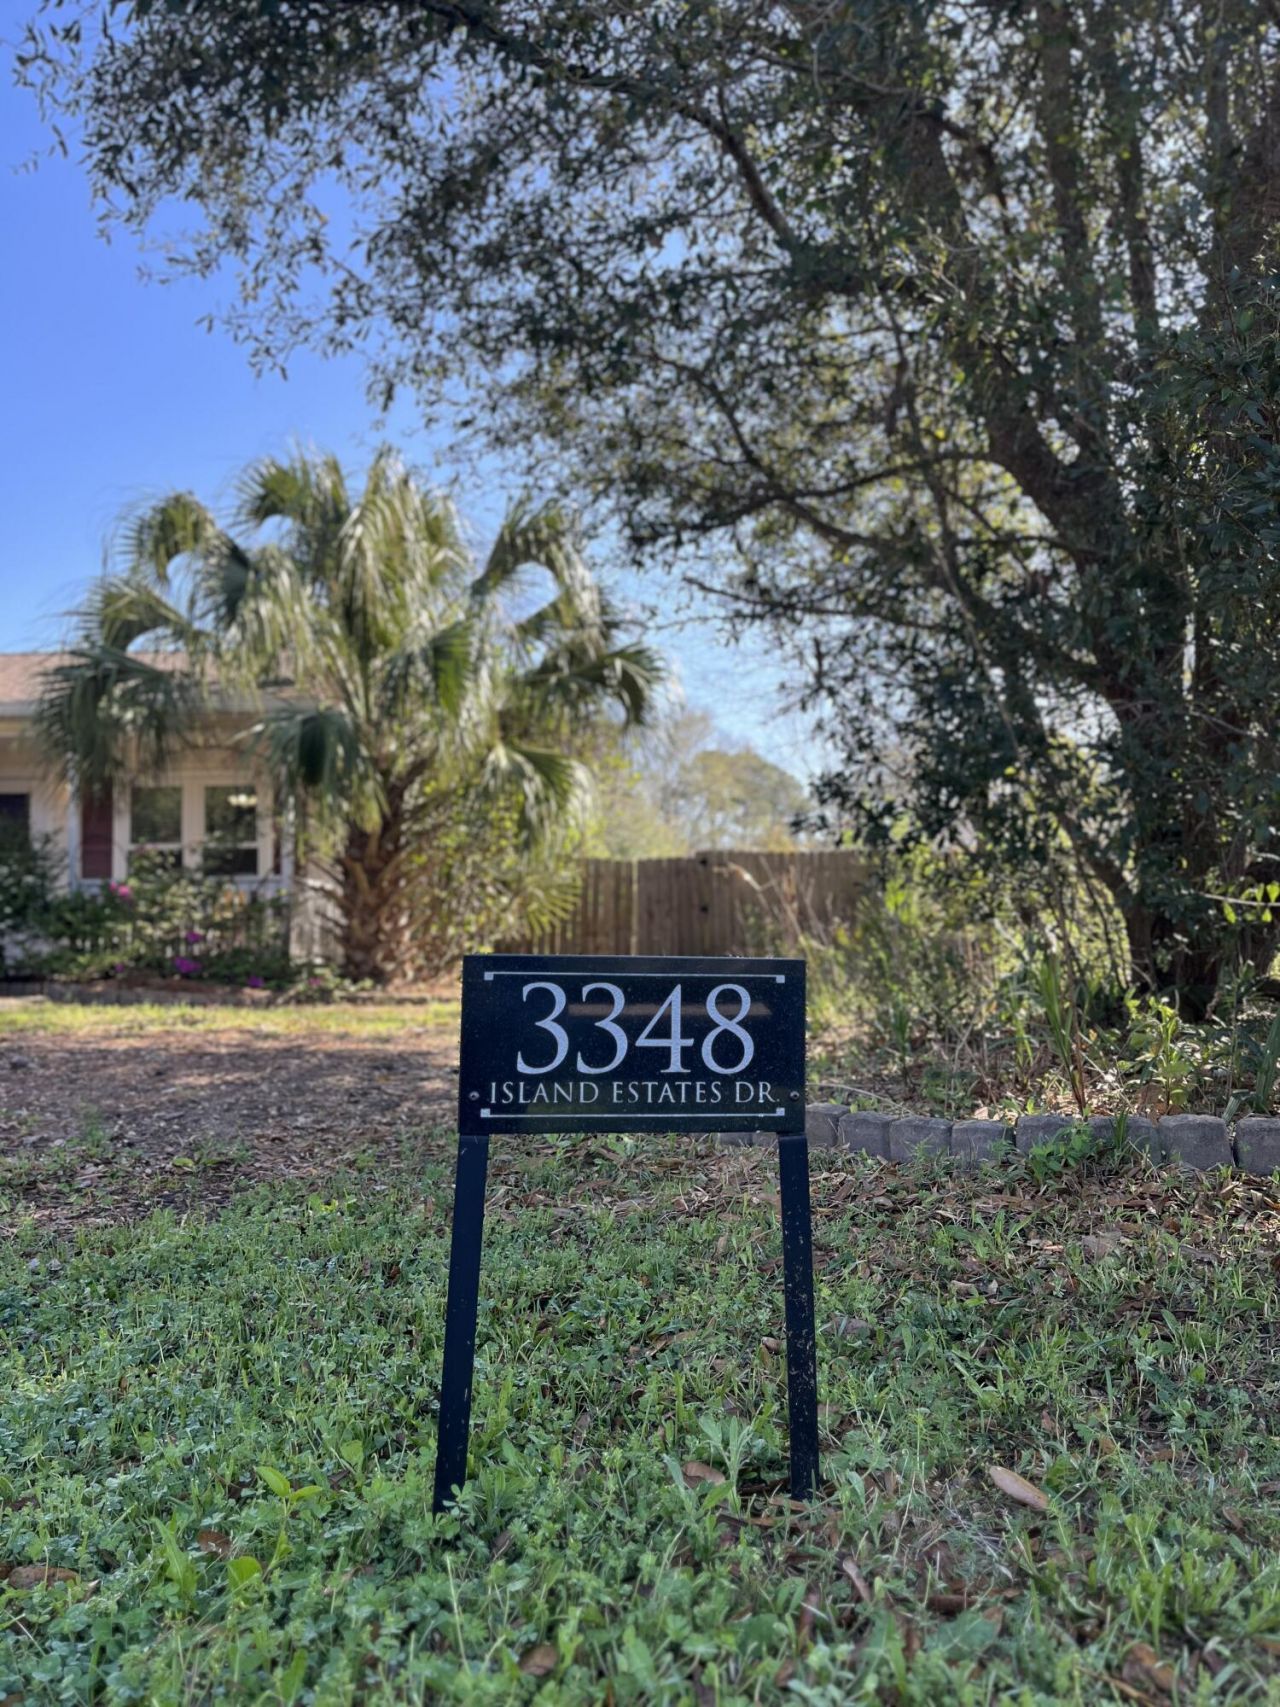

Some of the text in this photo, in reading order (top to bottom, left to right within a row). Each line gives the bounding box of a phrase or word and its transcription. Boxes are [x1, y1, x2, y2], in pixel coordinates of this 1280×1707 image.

[516, 982, 755, 1075] 3348
[490, 1081, 599, 1104] ISLAND
[612, 1081, 722, 1104] ESTATES
